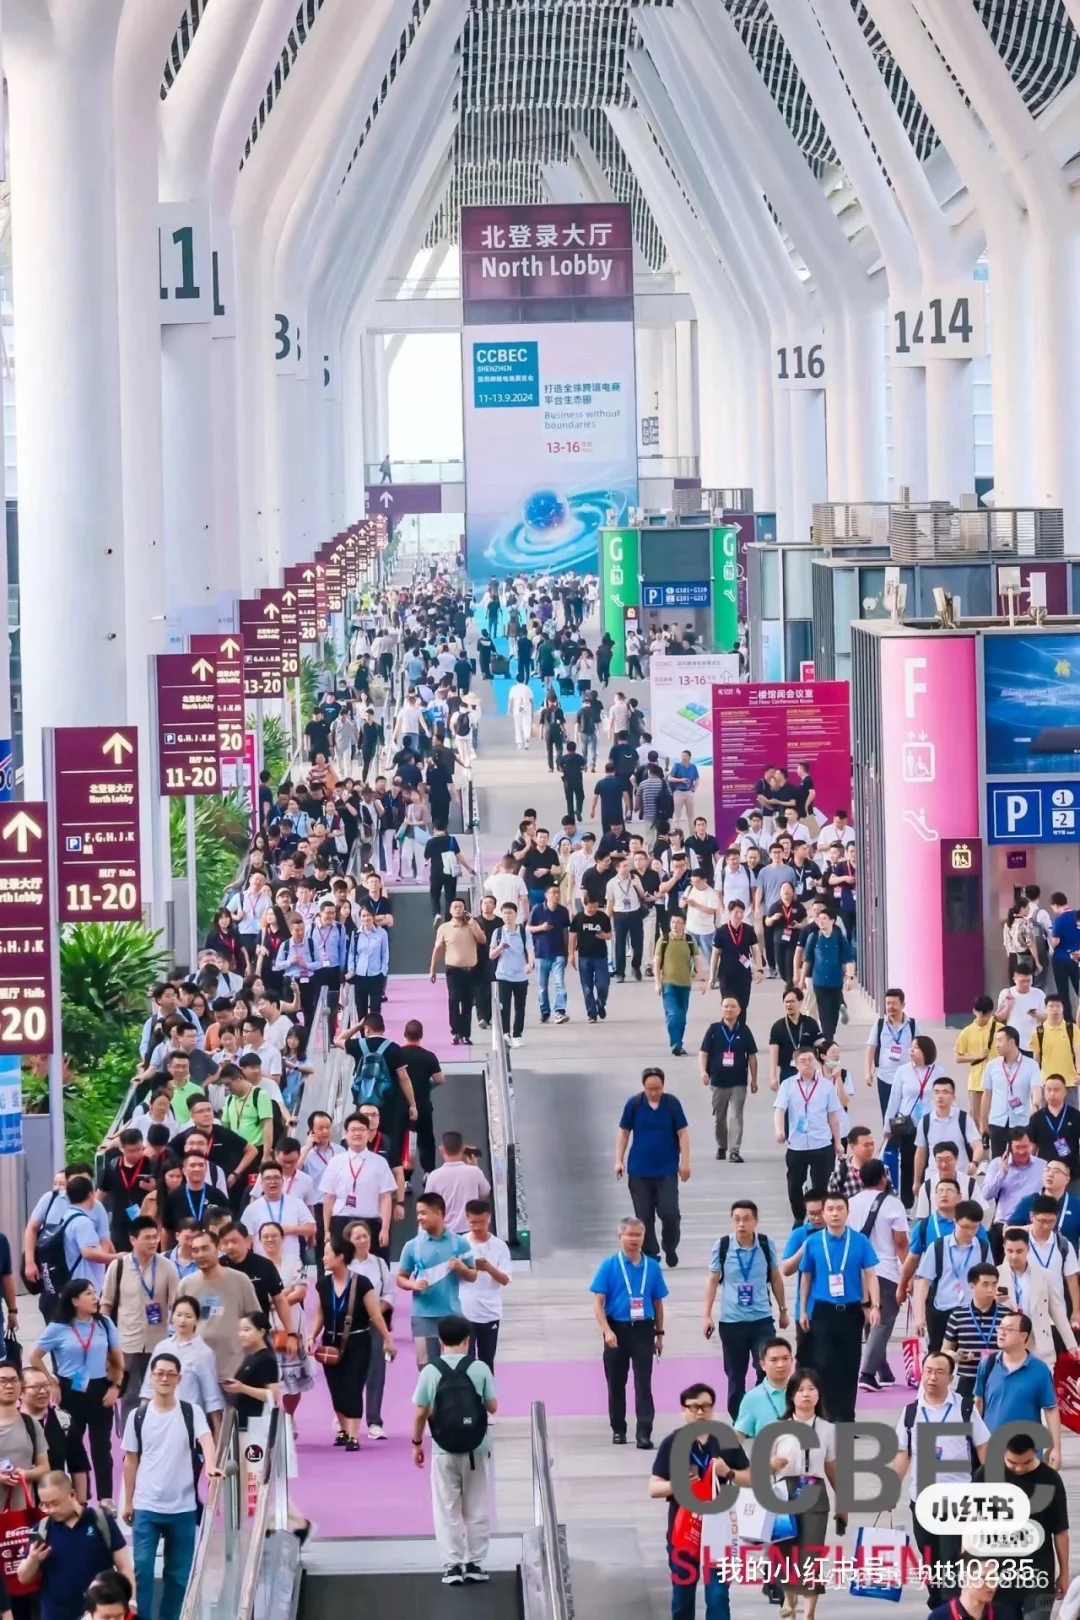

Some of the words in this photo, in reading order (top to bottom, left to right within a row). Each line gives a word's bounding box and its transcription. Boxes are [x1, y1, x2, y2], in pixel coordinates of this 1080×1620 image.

[481, 223, 612, 249] 北登录大厅
[482, 255, 543, 278] North
[550, 253, 613, 281] Lobby
[929, 298, 973, 344] 14
[476, 349, 528, 363] CCBEC
[476, 365, 513, 373] SHENZHEN
[544, 382, 621, 394] 打造全球跨境电商
[478, 393, 533, 403] 11-13.9.2024
[544, 395, 592, 405] 平台生态圈
[544, 411, 583, 420] Business
[586, 410, 620, 419] without
[544, 420, 596, 430] boundaries
[546, 442, 580, 453] 13-16
[609, 536, 623, 561] G
[723, 532, 734, 556] G
[282, 659, 298, 672] 20
[244, 679, 282, 694] 13-20
[678, 676, 706, 685] 13-16
[748, 689, 814, 700] 二楼馆间会议室
[904, 658, 927, 718] F
[220, 733, 242, 751] 20
[166, 767, 217, 788] 11-20
[89, 795, 111, 804] North
[112, 794, 134, 804] Lobby
[1056, 792, 1066, 804] -1
[1006, 796, 1028, 832] P
[1055, 812, 1068, 826] -2
[66, 883, 137, 910] 11-20
